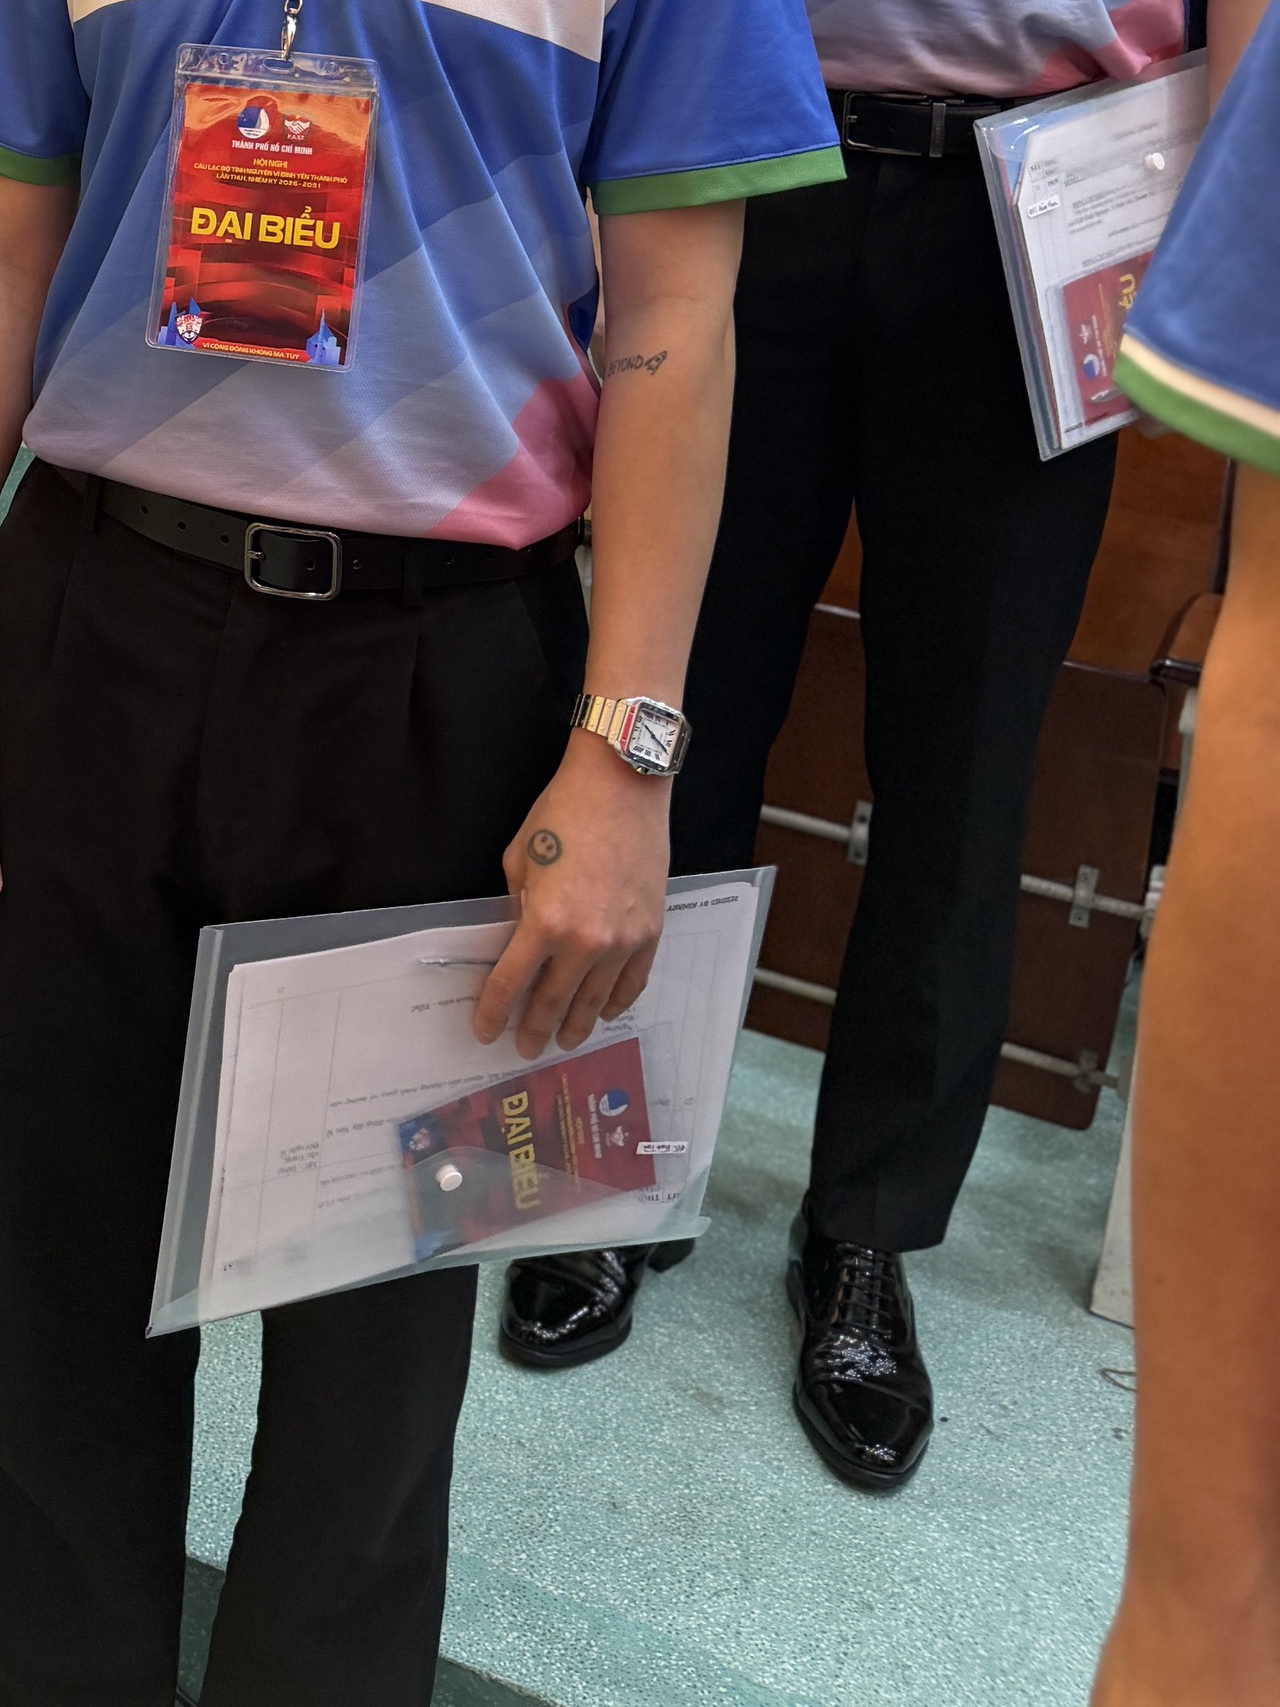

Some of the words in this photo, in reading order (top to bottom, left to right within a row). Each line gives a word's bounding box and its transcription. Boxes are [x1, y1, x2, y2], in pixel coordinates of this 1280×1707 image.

[191, 206, 252, 244] ĐẠI
[258, 205, 340, 250] BIỂU
[607, 354, 644, 378] BEYOND
[501, 1091, 534, 1144] ĐẠI
